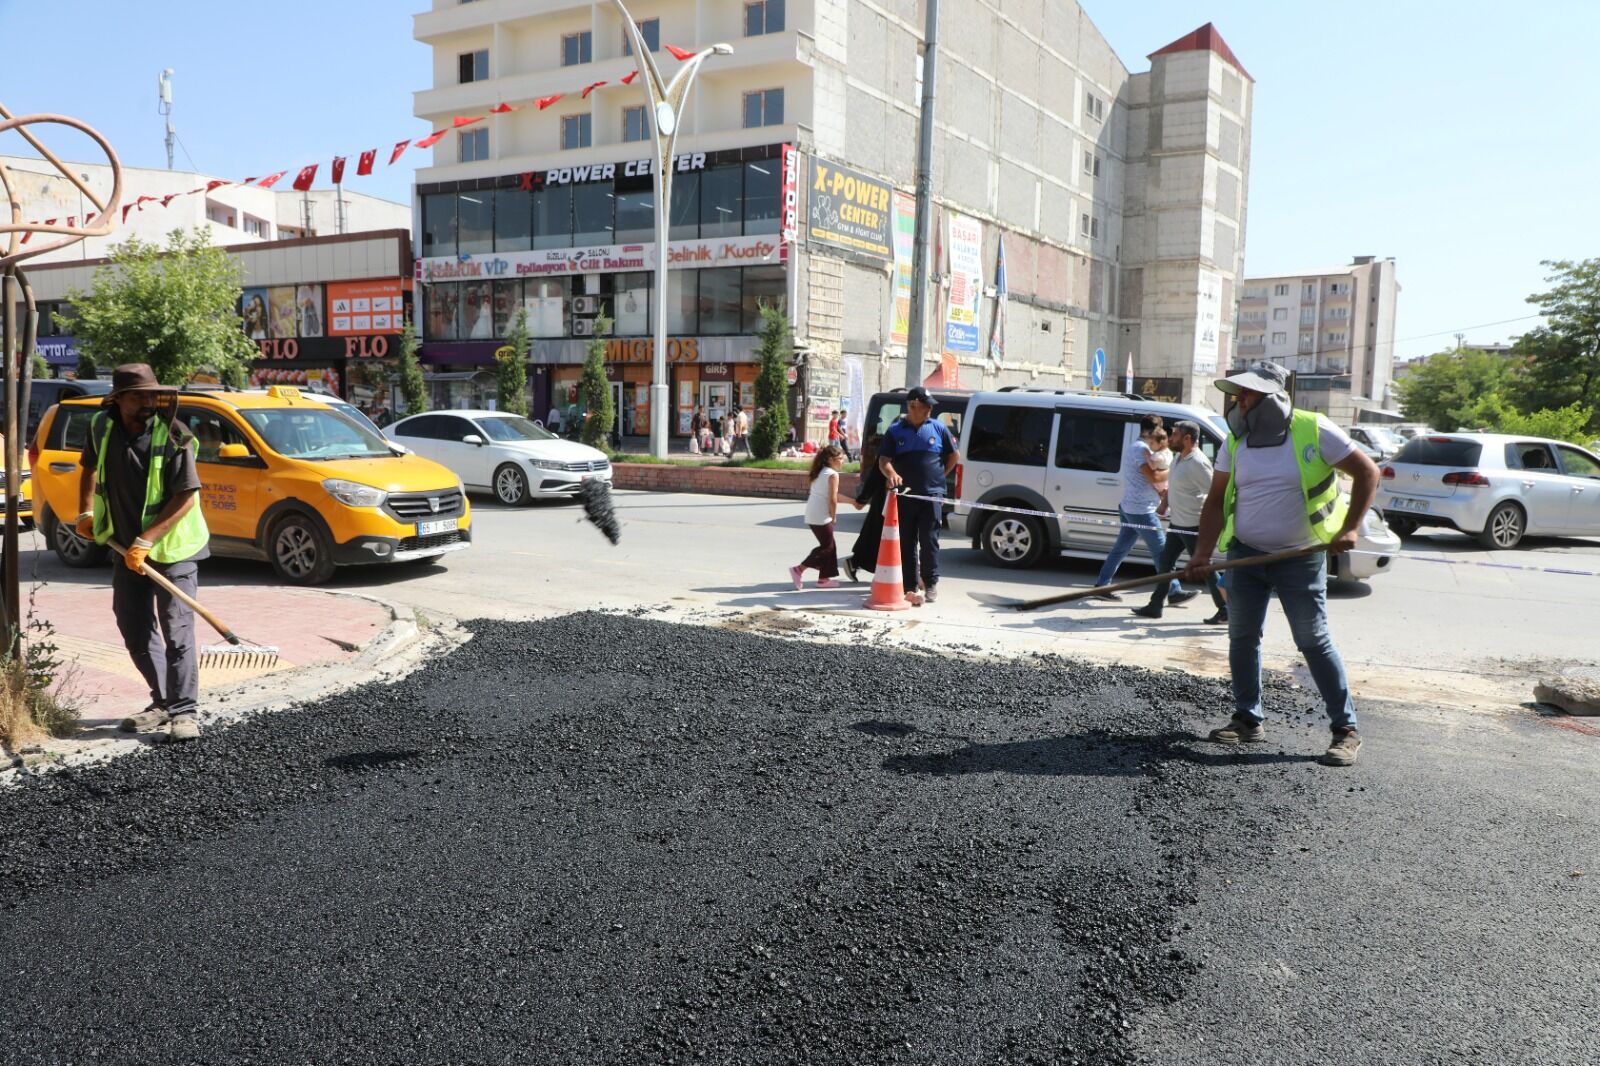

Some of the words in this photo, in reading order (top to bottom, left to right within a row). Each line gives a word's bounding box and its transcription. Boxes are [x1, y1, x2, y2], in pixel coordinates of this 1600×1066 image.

[624, 153, 706, 177] CEER
[785, 150, 796, 227] SPOR
[814, 165, 890, 213] X-POWER
[840, 203, 879, 229] CENTER
[836, 222, 850, 234] GYM
[869, 232, 883, 242] CLUB
[516, 263, 566, 276] Epilasyon
[580, 260, 599, 270] Cilt
[259, 339, 299, 360] FLO
[344, 335, 388, 358] FLO
